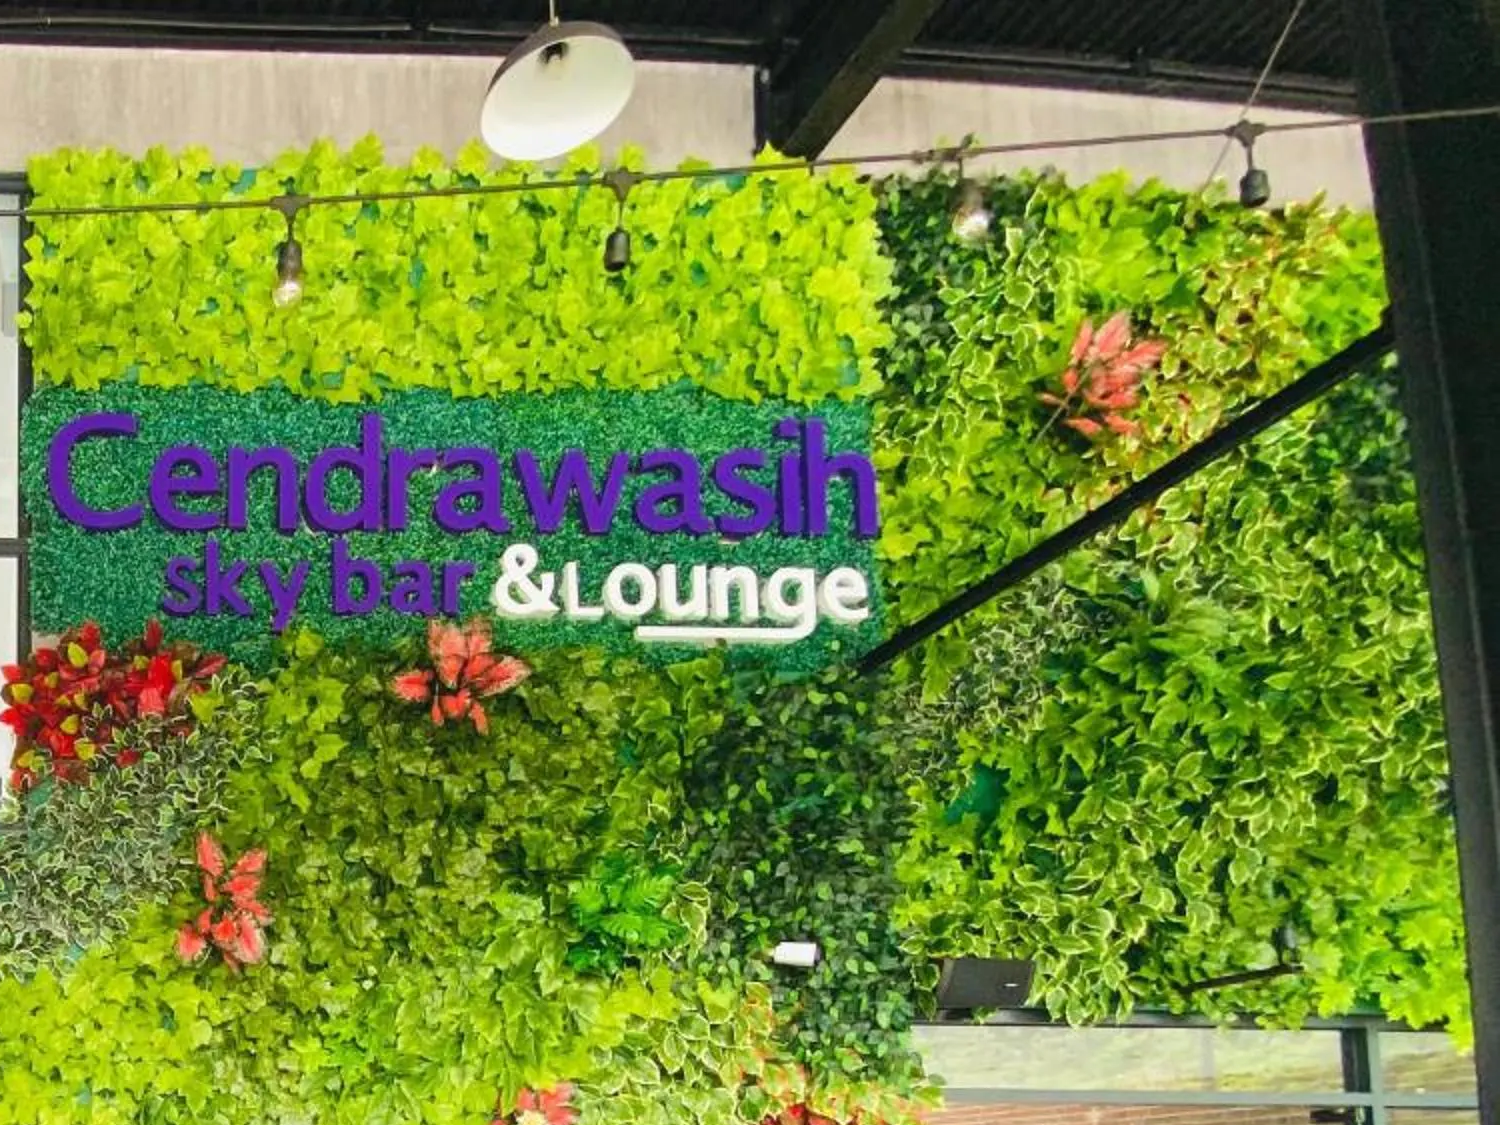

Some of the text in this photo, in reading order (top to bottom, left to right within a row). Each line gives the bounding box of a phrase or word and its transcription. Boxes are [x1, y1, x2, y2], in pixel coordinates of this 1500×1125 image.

[46, 411, 878, 538] Cendrawasih
[162, 538, 308, 633] sky
[332, 539, 475, 617] bar
